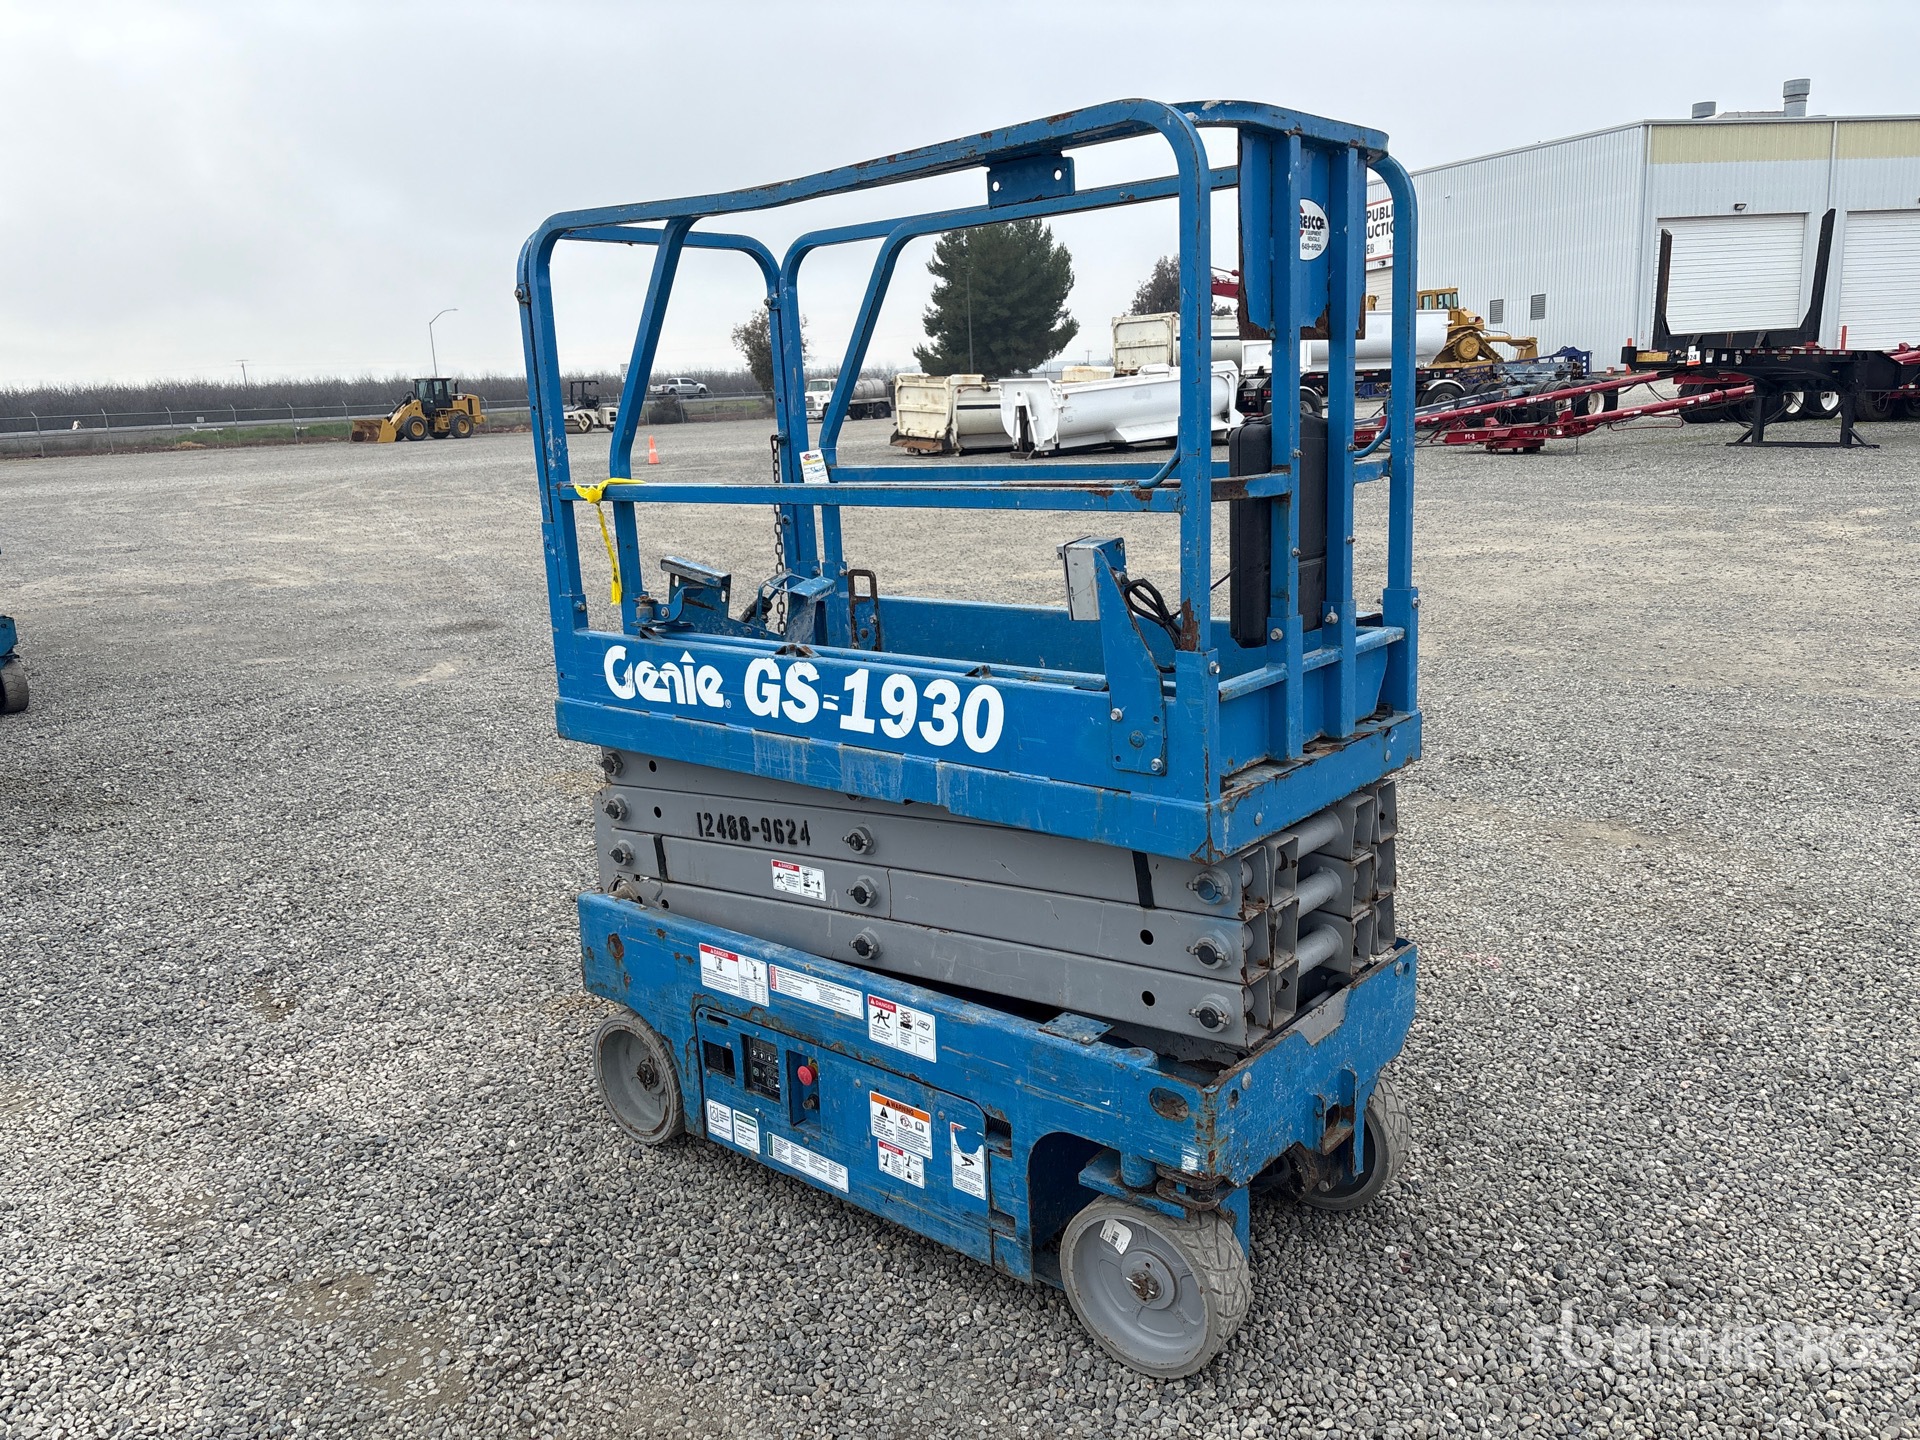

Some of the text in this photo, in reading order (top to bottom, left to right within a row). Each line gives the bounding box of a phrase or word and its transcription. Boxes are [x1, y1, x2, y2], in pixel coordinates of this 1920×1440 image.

[1366, 204, 1394, 223] PUBLI
[1366, 221, 1394, 240] UCTI
[1366, 243, 1375, 254] EB
[743, 656, 1005, 754] GS-1930
[696, 811, 811, 846] 12488-9624
[875, 999, 895, 1011] DANGER
[890, 1100, 915, 1116] WARNING
